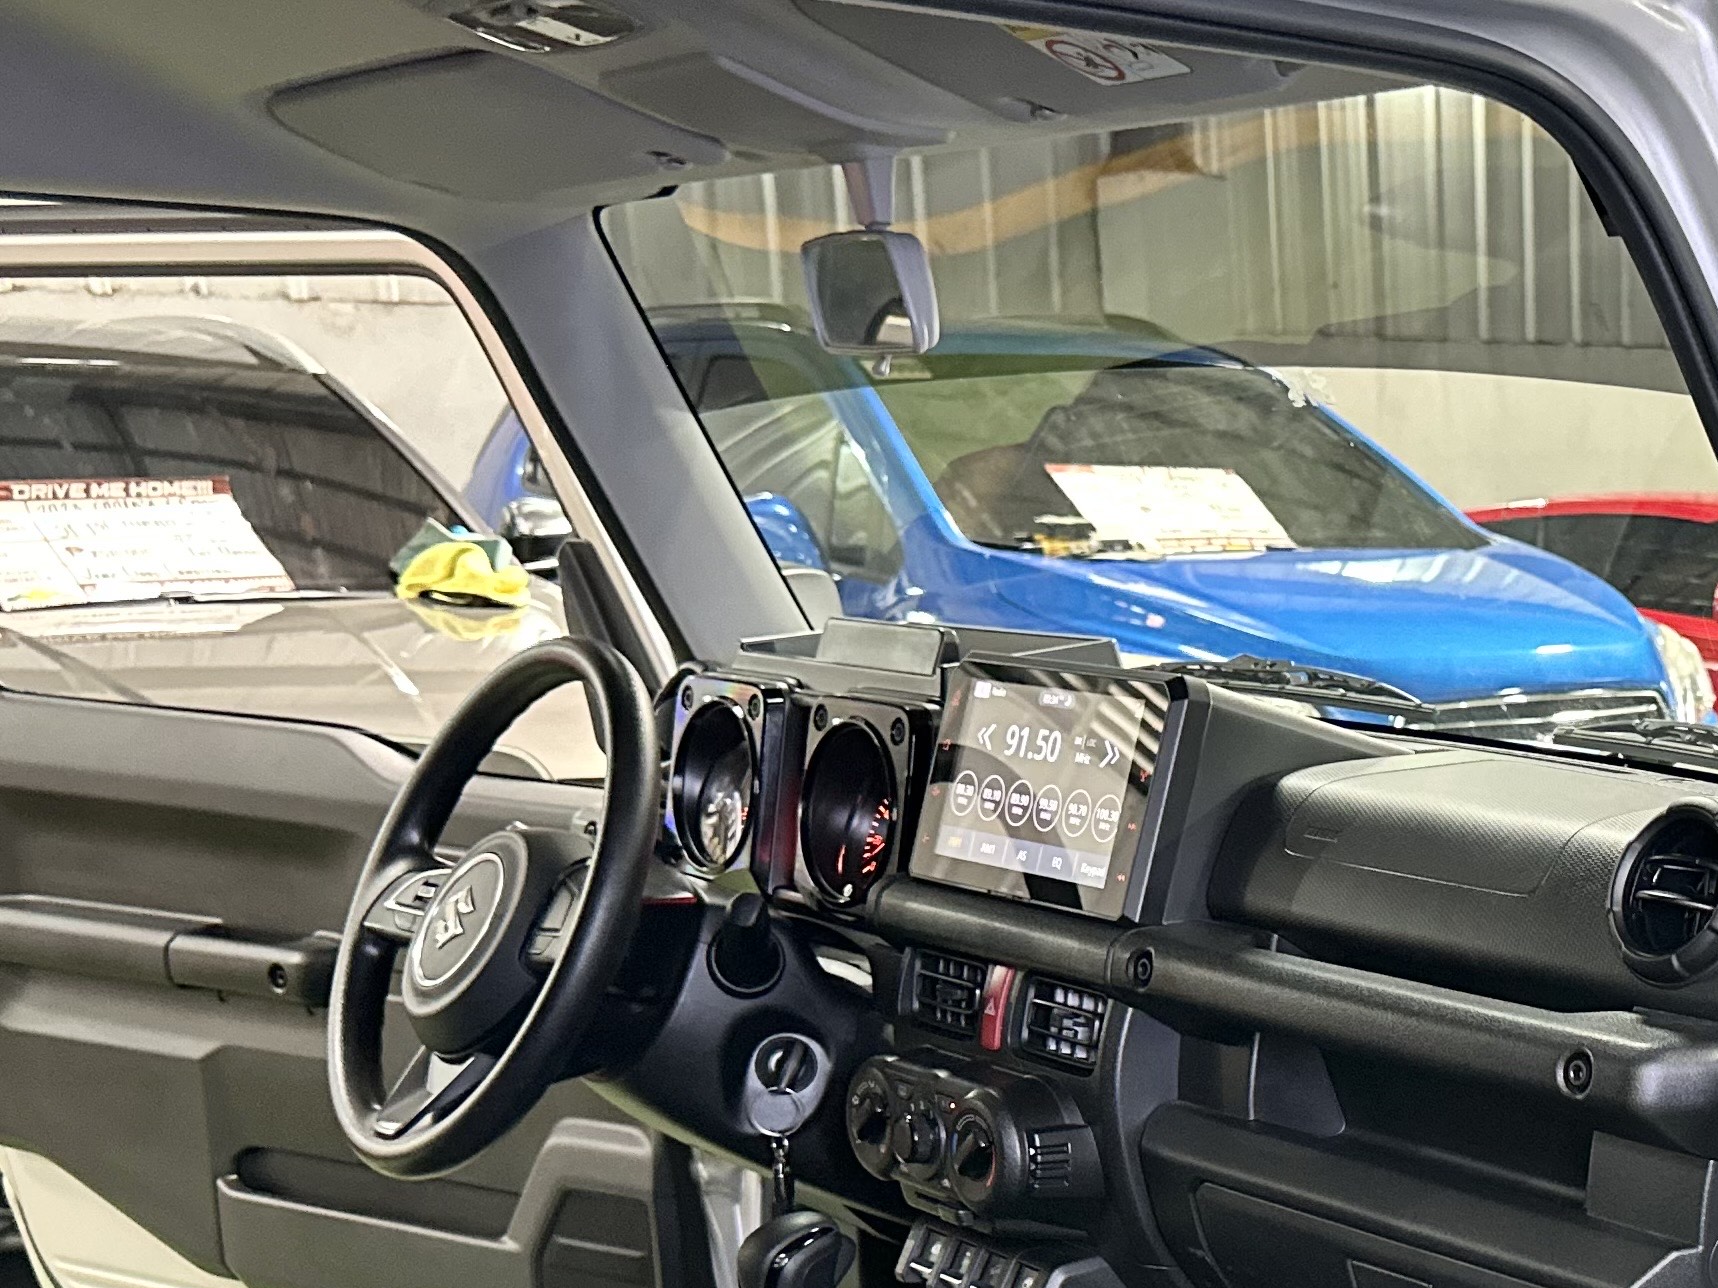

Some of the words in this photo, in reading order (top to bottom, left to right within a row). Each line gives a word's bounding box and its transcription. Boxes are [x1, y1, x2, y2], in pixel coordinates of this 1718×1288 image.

[11, 482, 87, 500] DRIVE
[90, 482, 127, 499] ME
[1004, 725, 1062, 762] 91.50
[1051, 856, 1062, 870] EQ
